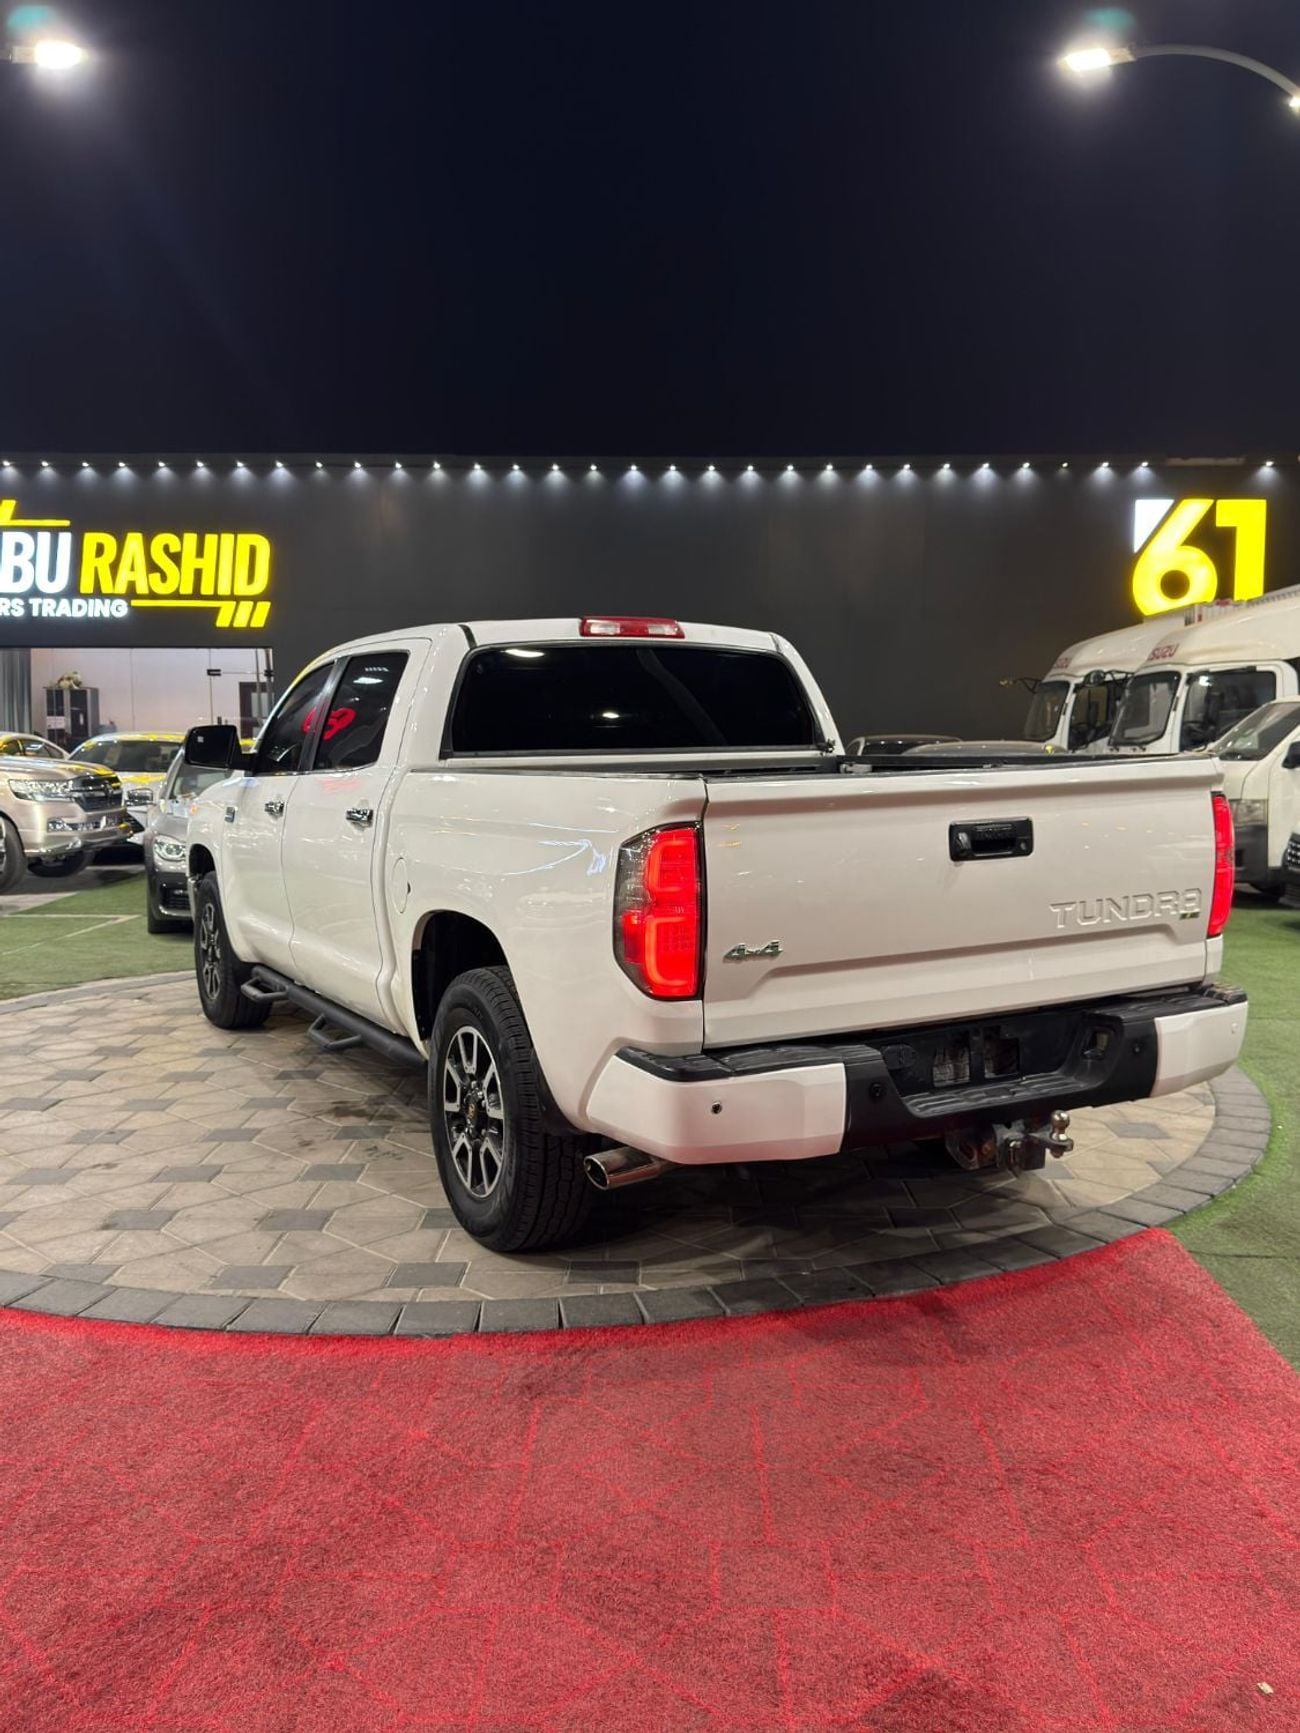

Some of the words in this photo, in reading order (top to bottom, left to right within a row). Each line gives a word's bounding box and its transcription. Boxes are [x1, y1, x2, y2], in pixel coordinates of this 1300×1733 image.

[0, 531, 71, 594] BU
[79, 532, 271, 596] RASHID
[1132, 498, 1267, 616] 61
[29, 598, 128, 618] TRADING
[1147, 643, 1179, 661] SUZU
[1050, 888, 1201, 928] TUNDRA
